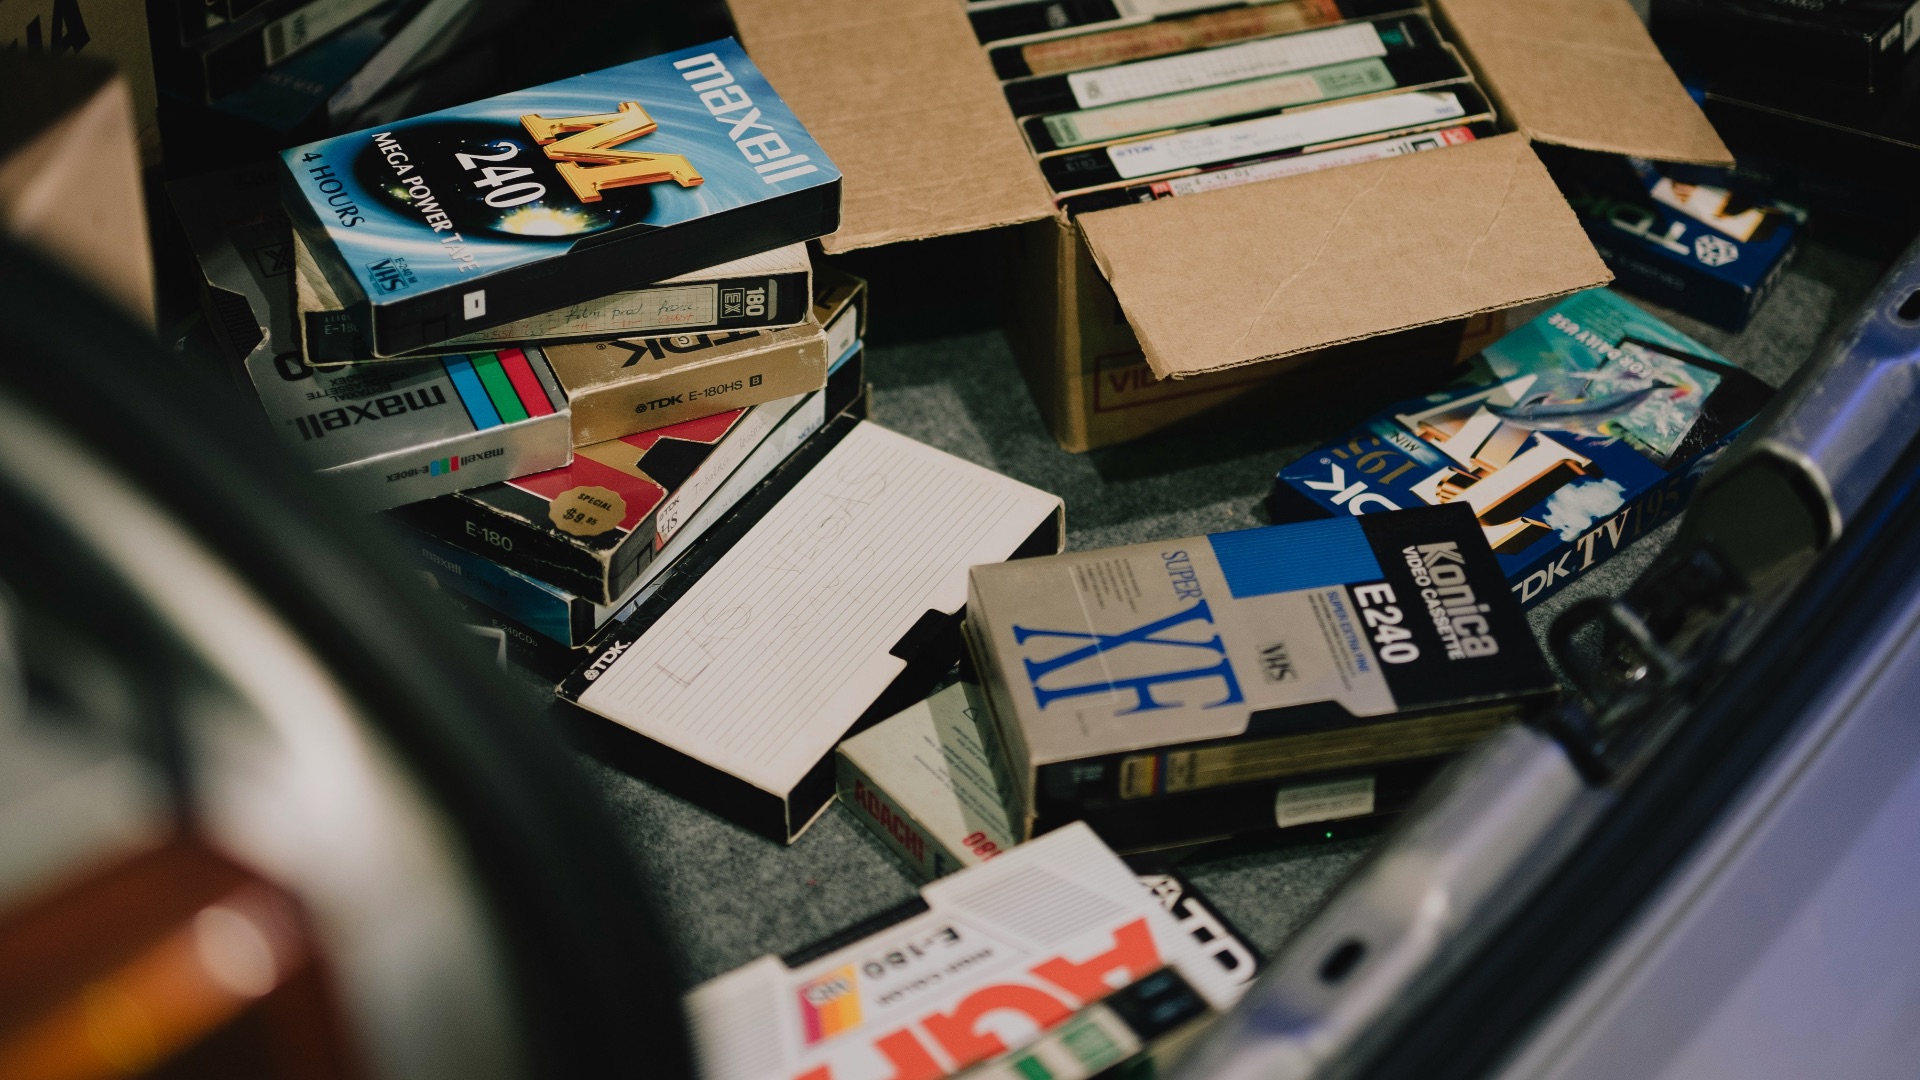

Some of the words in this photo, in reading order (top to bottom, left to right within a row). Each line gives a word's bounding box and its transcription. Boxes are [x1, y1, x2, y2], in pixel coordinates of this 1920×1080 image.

[673, 52, 819, 185] maxell
[301, 151, 317, 163] 4
[520, 101, 704, 203] M
[308, 163, 365, 229] HOURS
[454, 141, 546, 209] 240
[371, 130, 413, 178] MEGA
[409, 169, 454, 233] POWER
[440, 231, 481, 273] TAPE
[369, 258, 404, 293] VHS
[394, 257, 412, 279] E-240
[723, 289, 743, 316] EX
[746, 287, 765, 317] 180
[294, 385, 447, 441] maxell
[647, 394, 683, 410] TDK
[688, 380, 743, 402] E-180HS
[386, 464, 429, 483] E-180EX
[460, 447, 504, 467] maxell
[1336, 434, 1420, 487] 195
[577, 492, 613, 511] SPECIAL
[1303, 463, 1402, 516] DK
[465, 520, 513, 552] E-180
[660, 511, 679, 534] HS
[1576, 507, 1632, 576] TV
[421, 547, 462, 576] maxell
[1160, 550, 1204, 601] SUPER
[1326, 590, 1349, 624] SUPER
[1402, 545, 1431, 587] VIDEO
[1420, 588, 1466, 662] CASSETTE
[1416, 540, 1499, 658] Konica
[656, 601, 752, 689] LAS
[1353, 582, 1420, 665] E240
[591, 640, 630, 672] TDK
[1262, 643, 1295, 682] VHS
[861, 925, 962, 982] E-180
